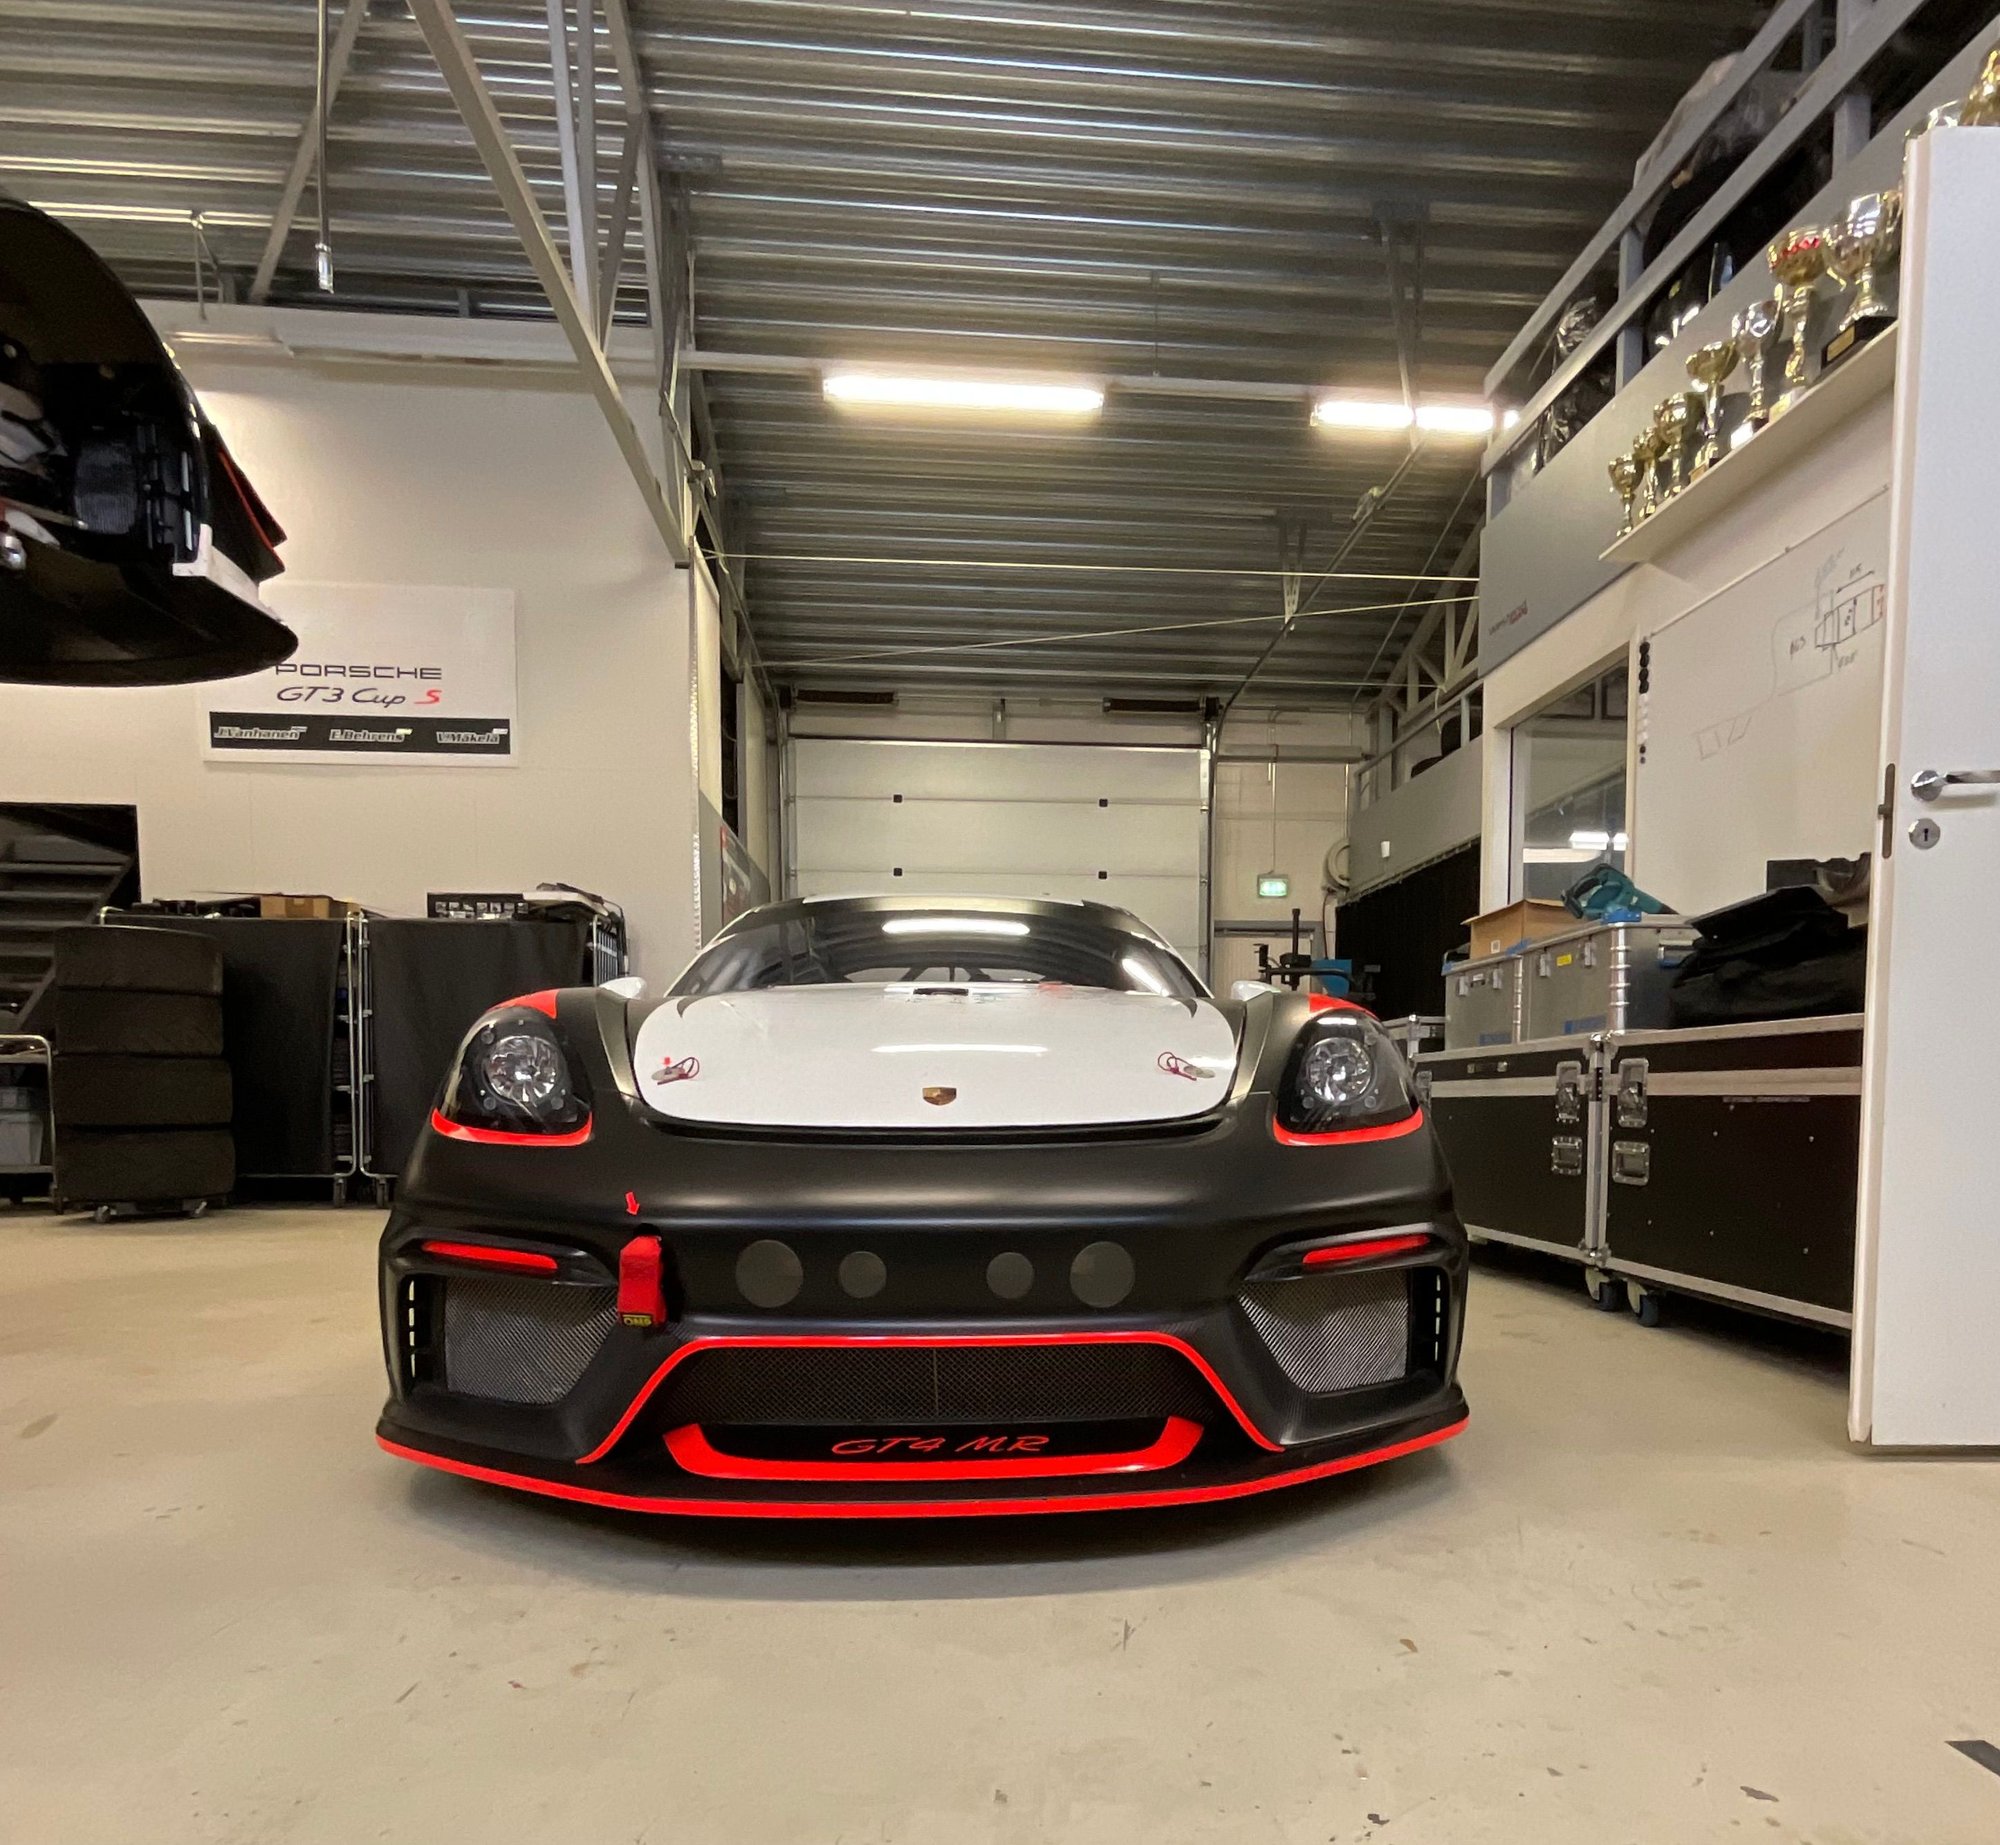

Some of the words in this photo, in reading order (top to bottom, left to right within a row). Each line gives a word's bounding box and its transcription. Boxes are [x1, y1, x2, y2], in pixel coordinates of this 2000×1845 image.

[275, 663, 442, 680] PORSCHE
[276, 686, 344, 702] GT3
[352, 687, 406, 708] Cup
[414, 689, 442, 705] S
[831, 1437, 946, 1455] GT4
[954, 1436, 1049, 1452] MR
